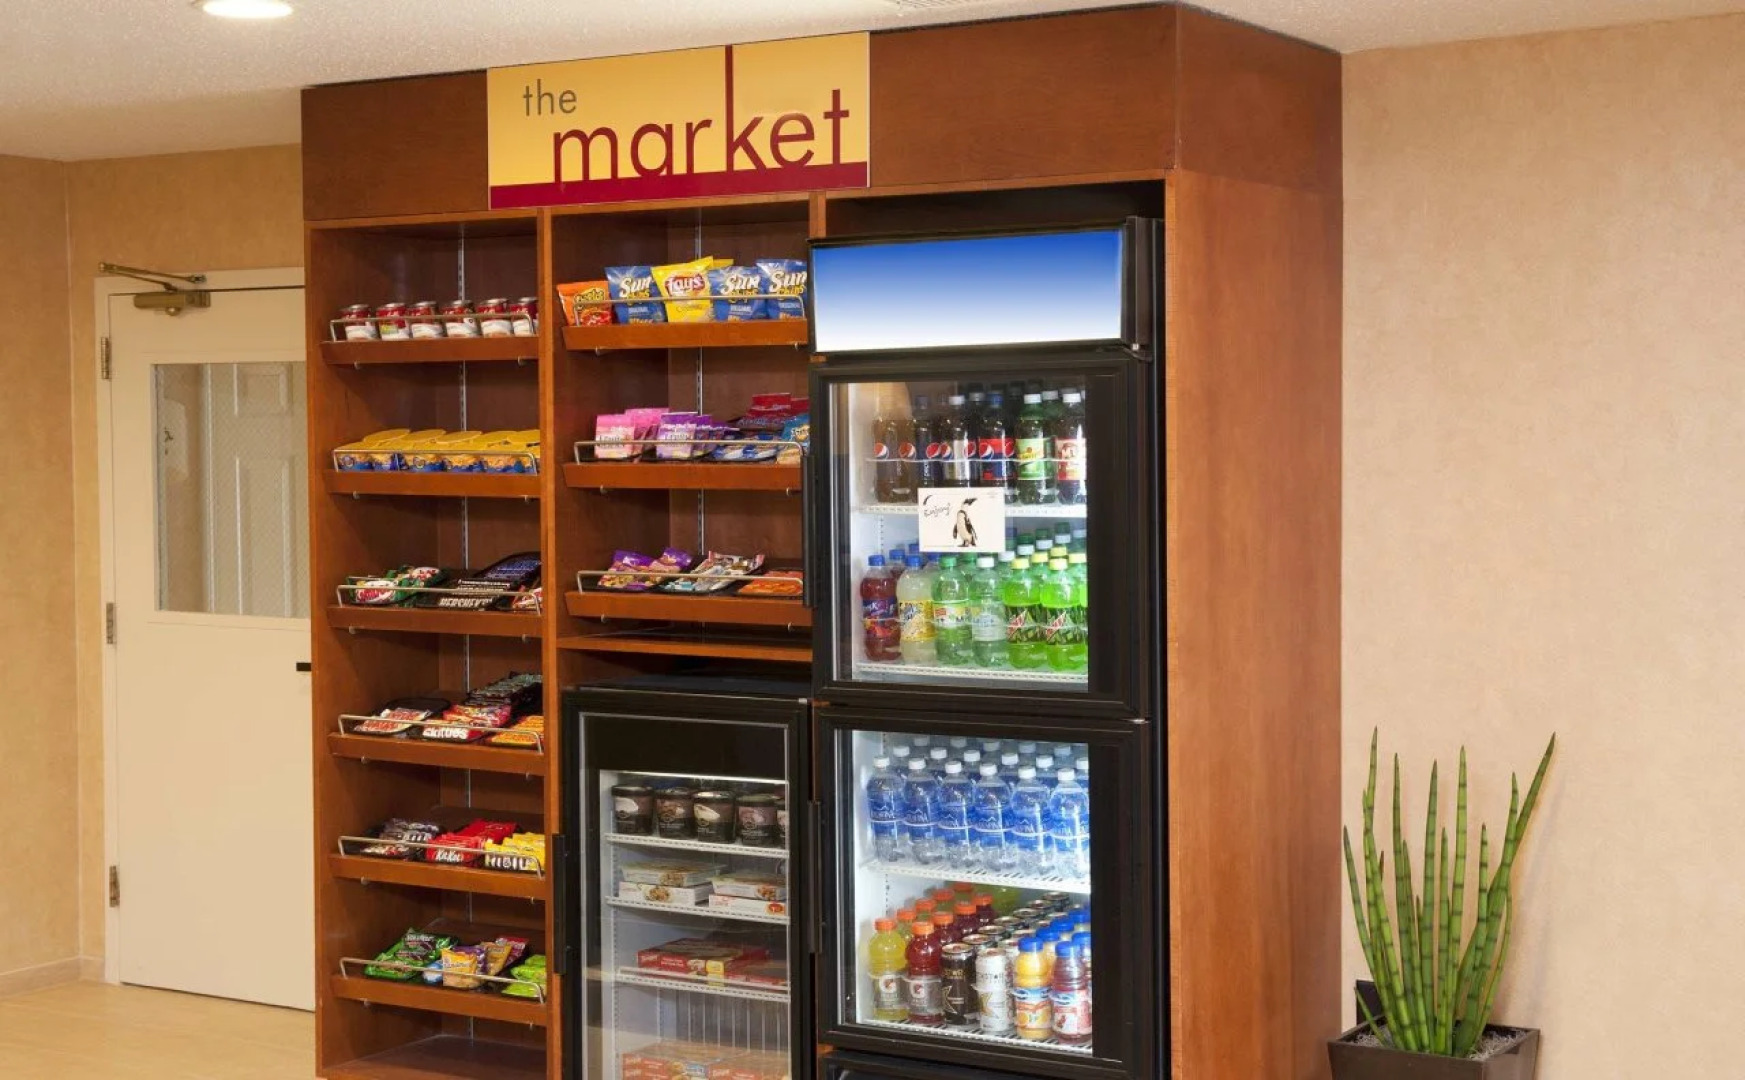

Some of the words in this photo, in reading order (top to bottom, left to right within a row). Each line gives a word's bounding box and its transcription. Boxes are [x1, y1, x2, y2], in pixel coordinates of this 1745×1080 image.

[522, 78, 578, 116] the
[553, 45, 850, 184] market
[619, 276, 652, 298] Sun
[721, 273, 761, 295] Sun
[768, 270, 805, 293] Sun
